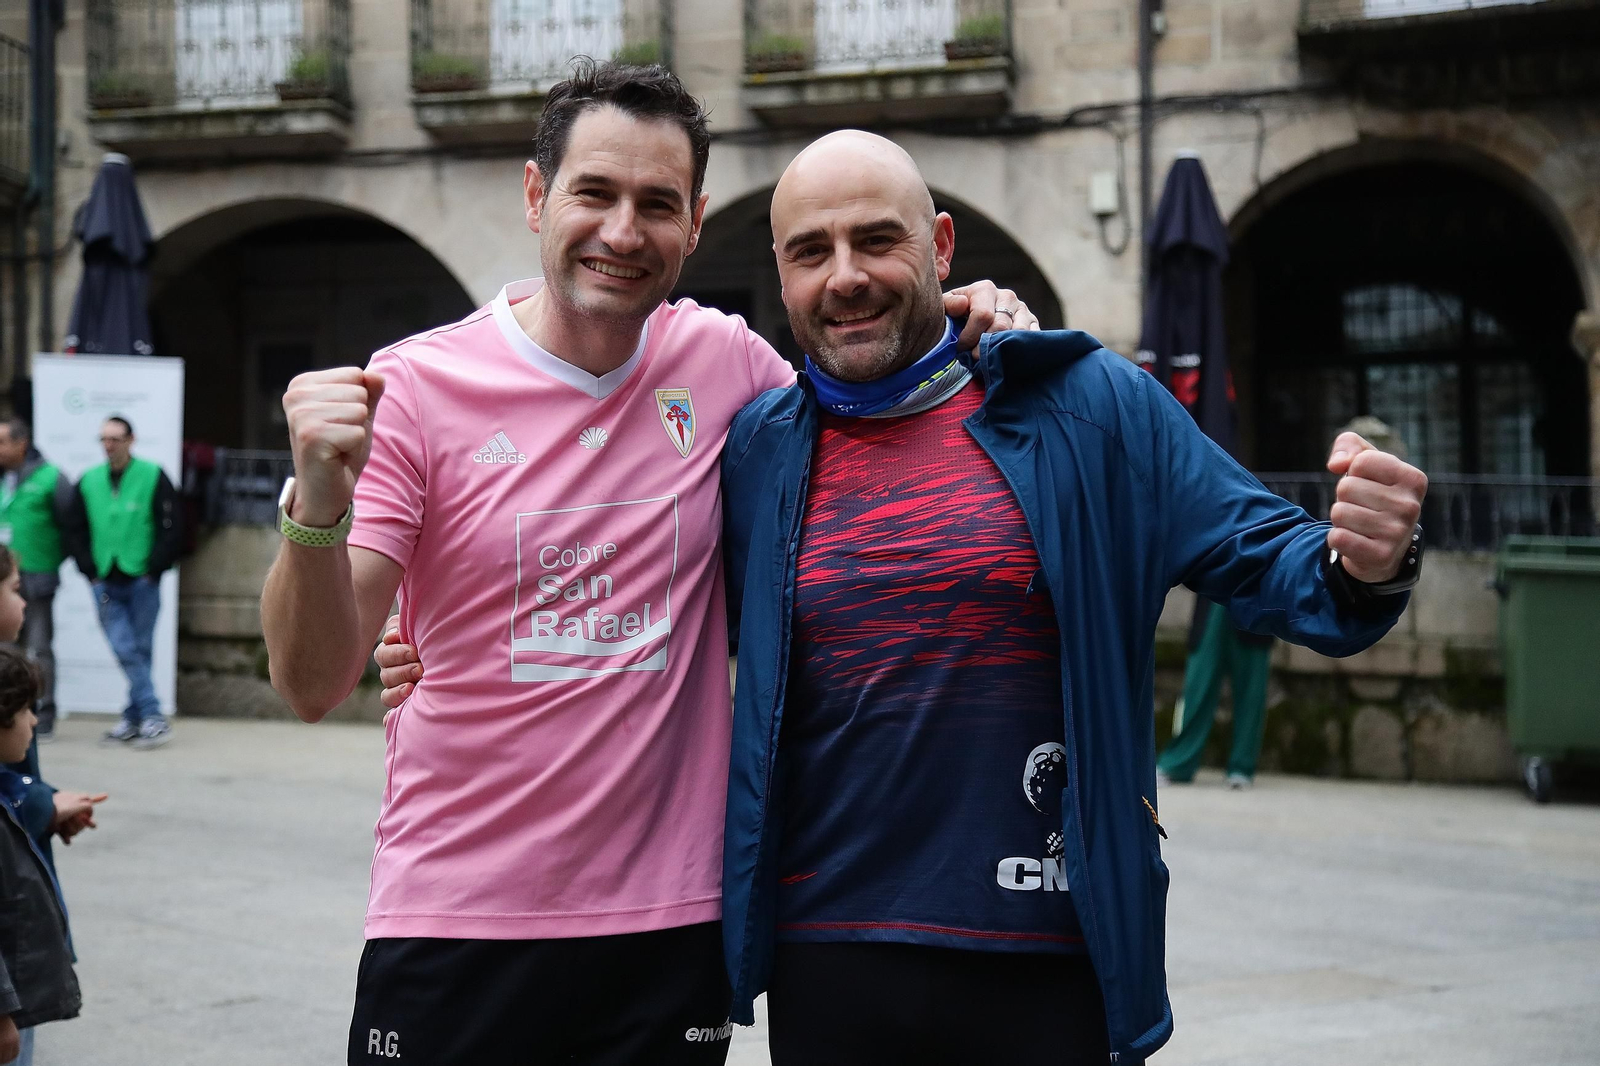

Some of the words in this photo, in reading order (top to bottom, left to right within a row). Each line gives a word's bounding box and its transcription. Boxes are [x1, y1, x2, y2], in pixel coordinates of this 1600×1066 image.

[473, 452, 527, 464] adidas
[538, 541, 618, 570] Cobre
[535, 574, 613, 605] San
[530, 603, 651, 640] Rafael
[367, 1028, 401, 1058] R.G.
